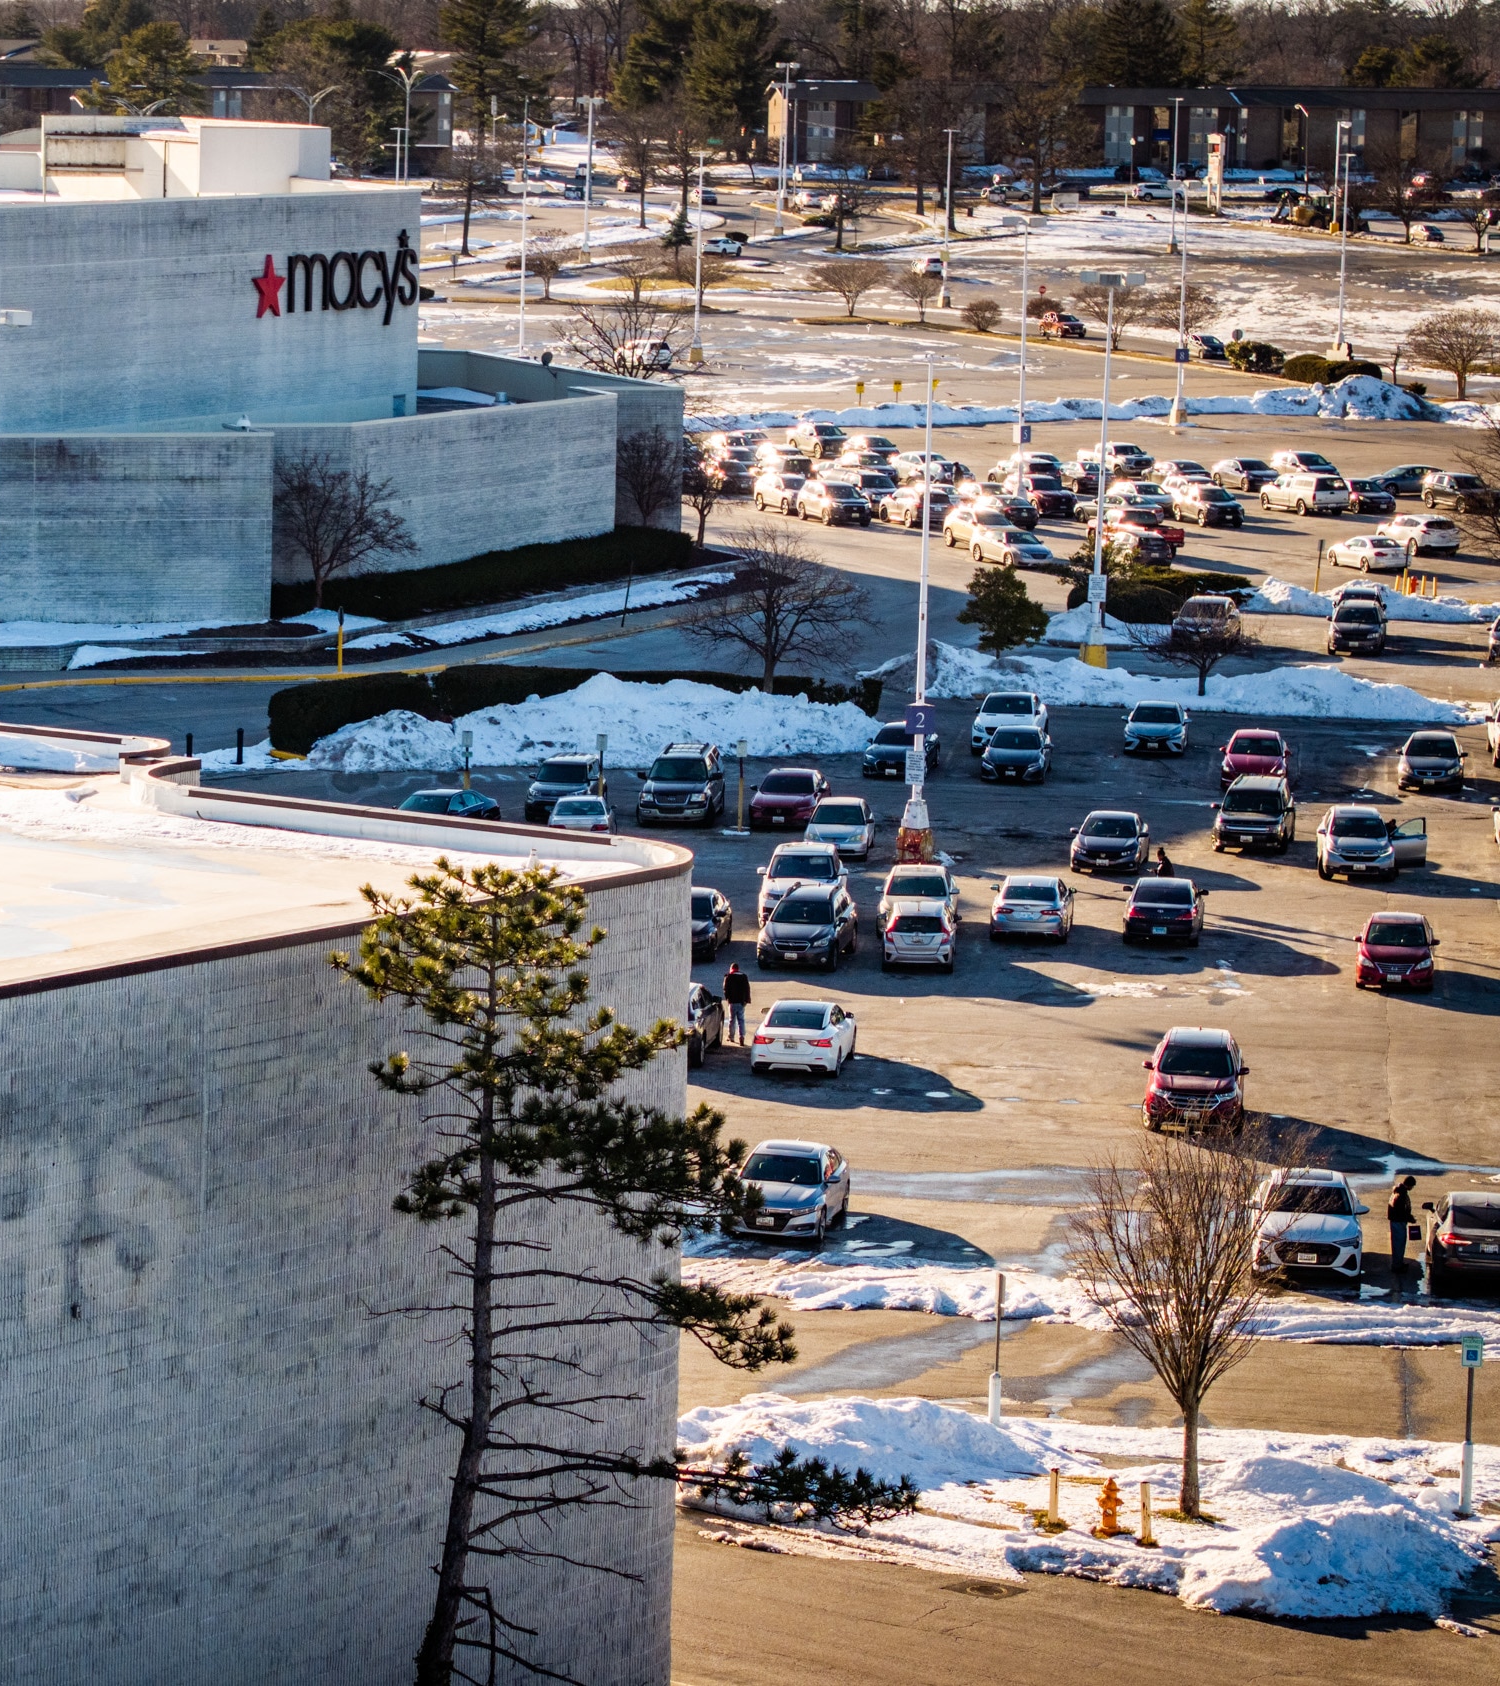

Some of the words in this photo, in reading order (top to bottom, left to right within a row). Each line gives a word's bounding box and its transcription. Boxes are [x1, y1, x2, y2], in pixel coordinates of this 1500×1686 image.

[1179, 351, 1185, 360] 8
[1023, 429, 1028, 440] 5
[915, 712, 925, 728] 2
